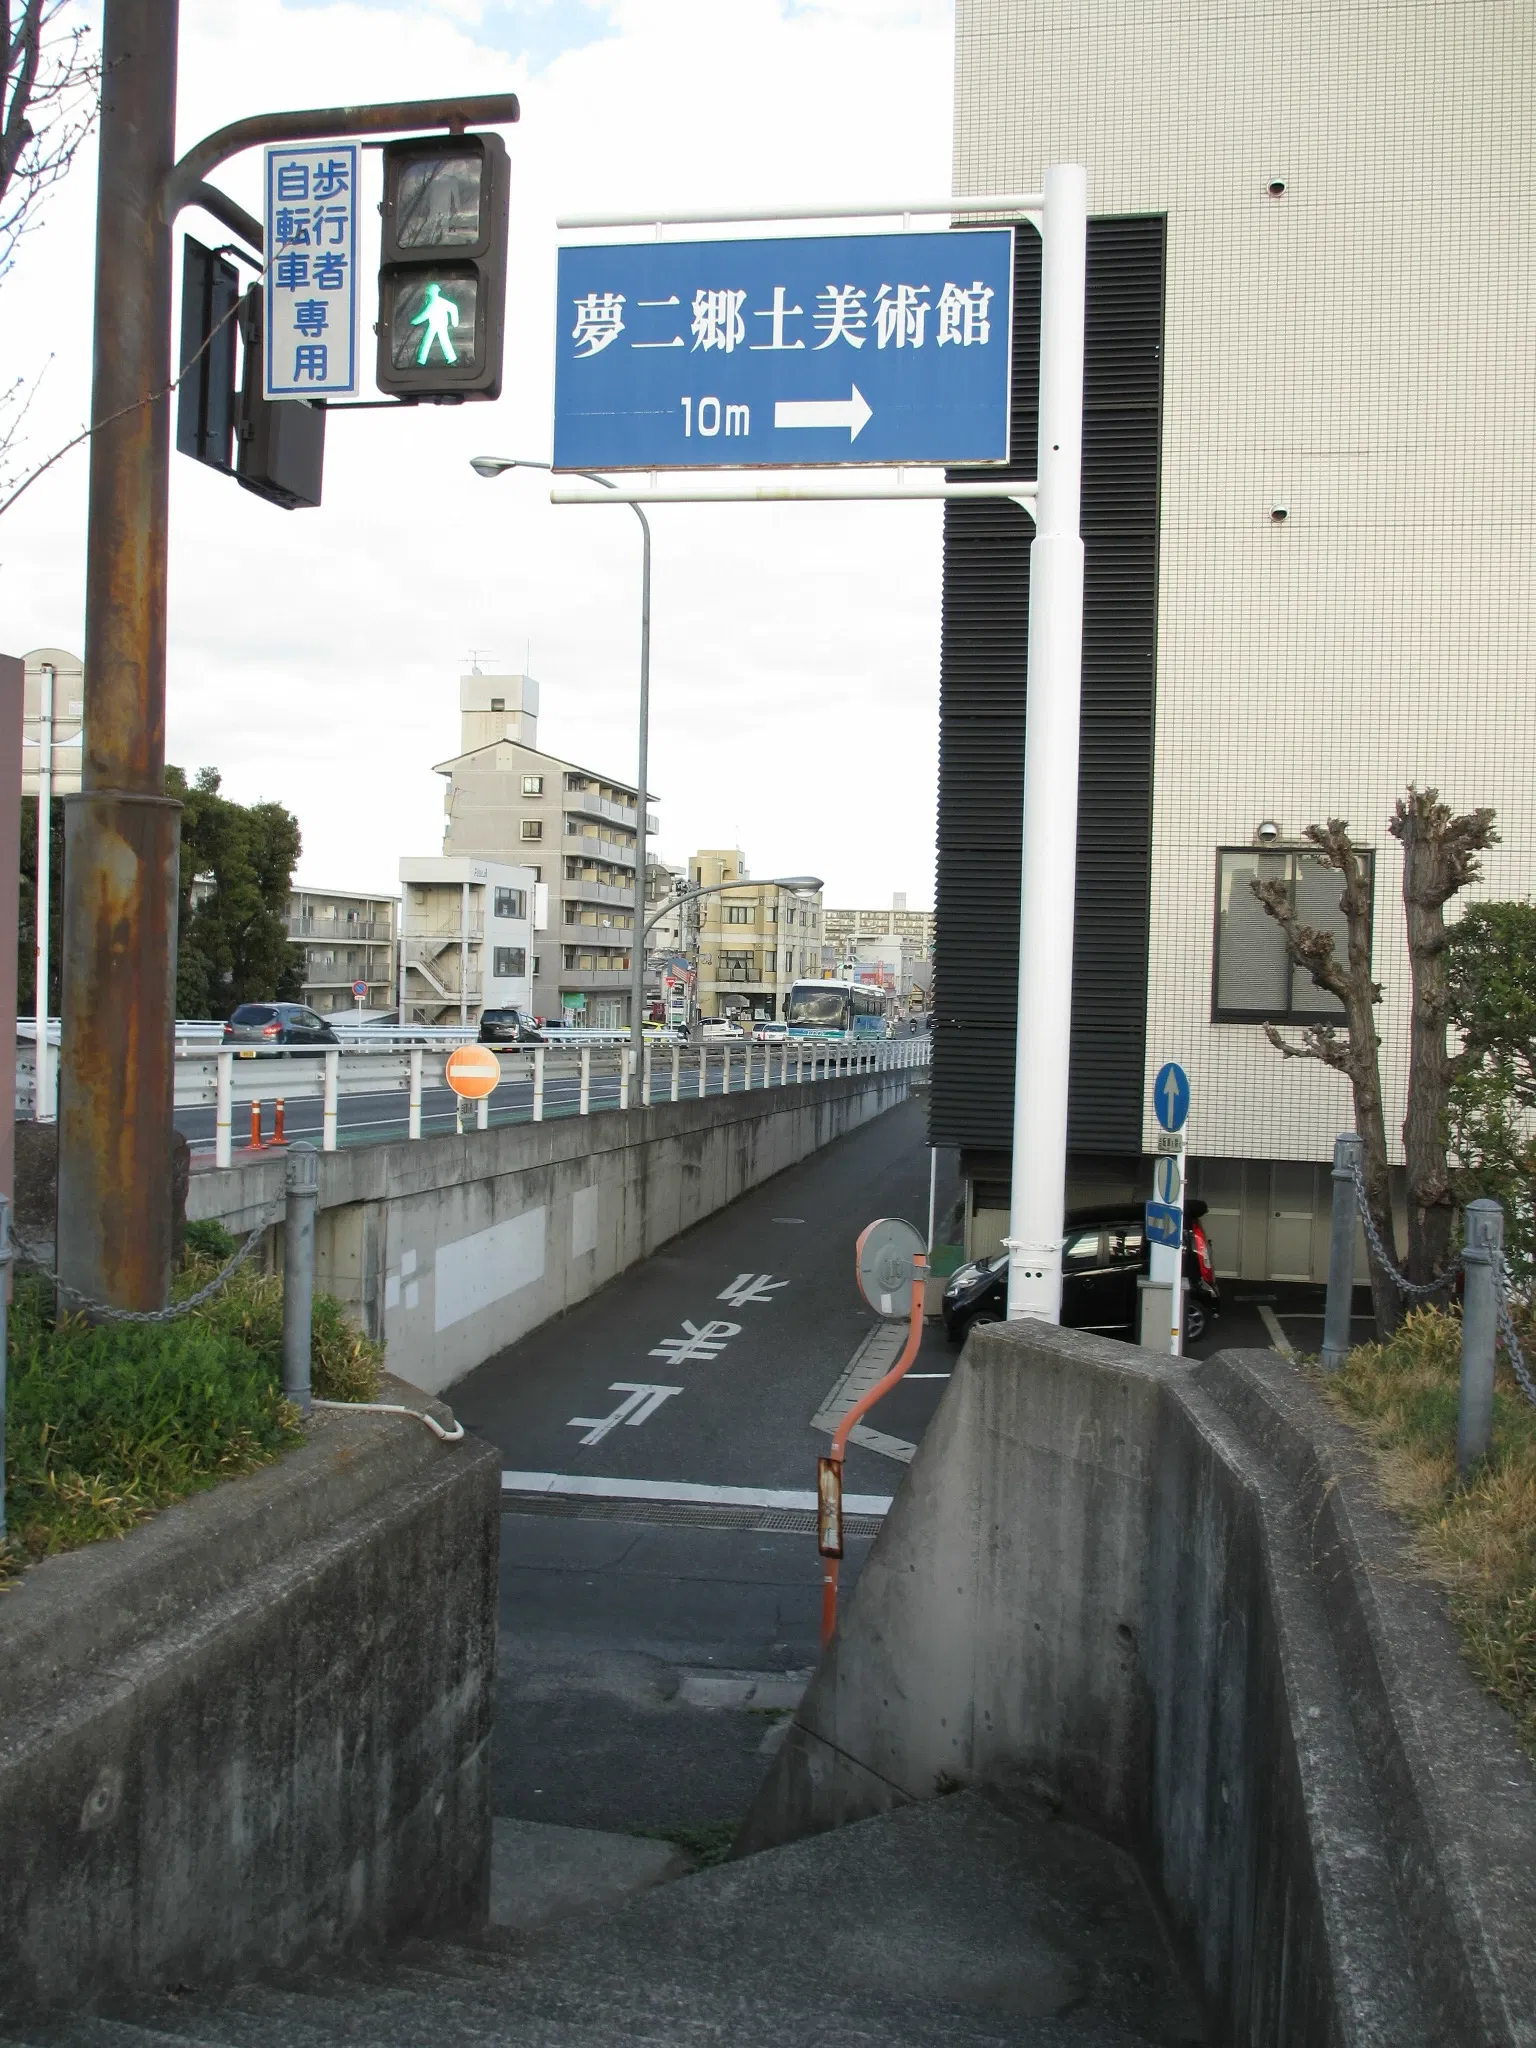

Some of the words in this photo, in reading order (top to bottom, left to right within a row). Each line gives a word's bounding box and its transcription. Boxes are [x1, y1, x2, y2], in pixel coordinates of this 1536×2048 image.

[274, 162, 311, 293] 自転車
[312, 159, 349, 291] 歩行者
[293, 299, 329, 382] 専用
[571, 281, 996, 360] 夢二郷土美術館
[680, 396, 750, 437] 10m
[566, 1273, 791, 1446] 止まれ
